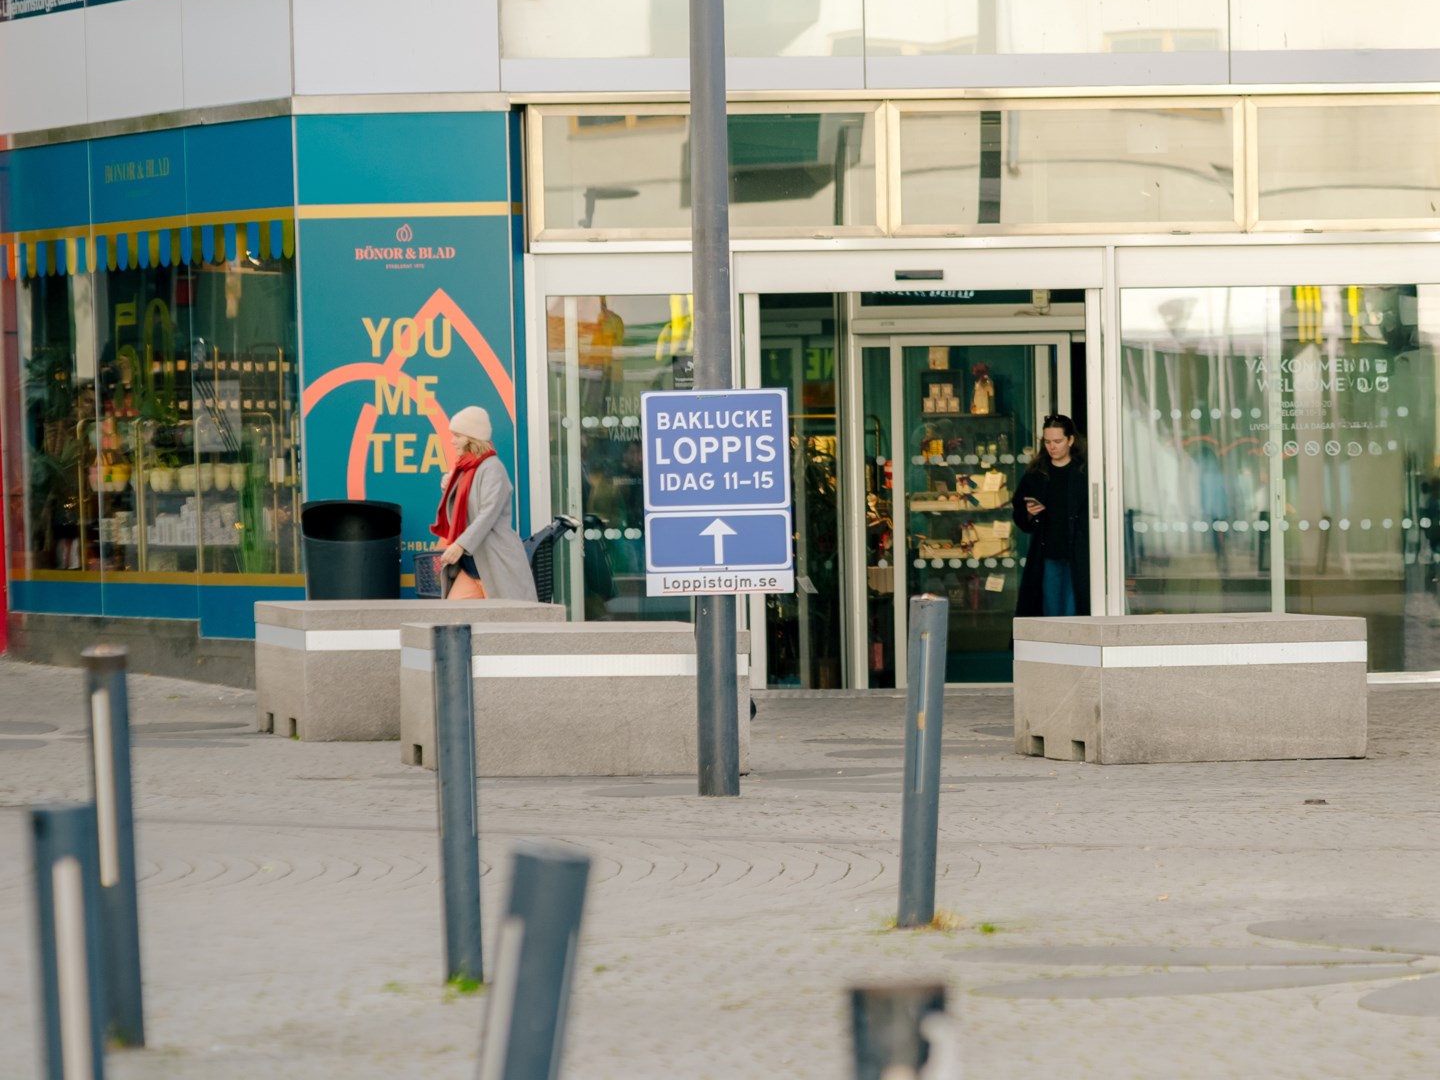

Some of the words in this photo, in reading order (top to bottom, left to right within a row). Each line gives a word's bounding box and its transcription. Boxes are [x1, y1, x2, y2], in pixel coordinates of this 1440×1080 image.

[354, 245, 403, 260] BÖNOR
[405, 247, 417, 260] &
[418, 247, 456, 259] BLAD
[361, 317, 452, 358] YOU
[1245, 356, 1353, 374] VÄKOMMEN
[375, 375, 439, 416] ME
[656, 409, 773, 431] BAKLUCKE
[608, 424, 642, 441] VARDA
[365, 432, 449, 474] TEA
[655, 434, 777, 465] LOPPIS
[659, 472, 715, 491] IDAG
[723, 470, 775, 490] 11-15
[400, 540, 436, 552] CHBLA
[663, 576, 777, 591] Loppistajm.se
